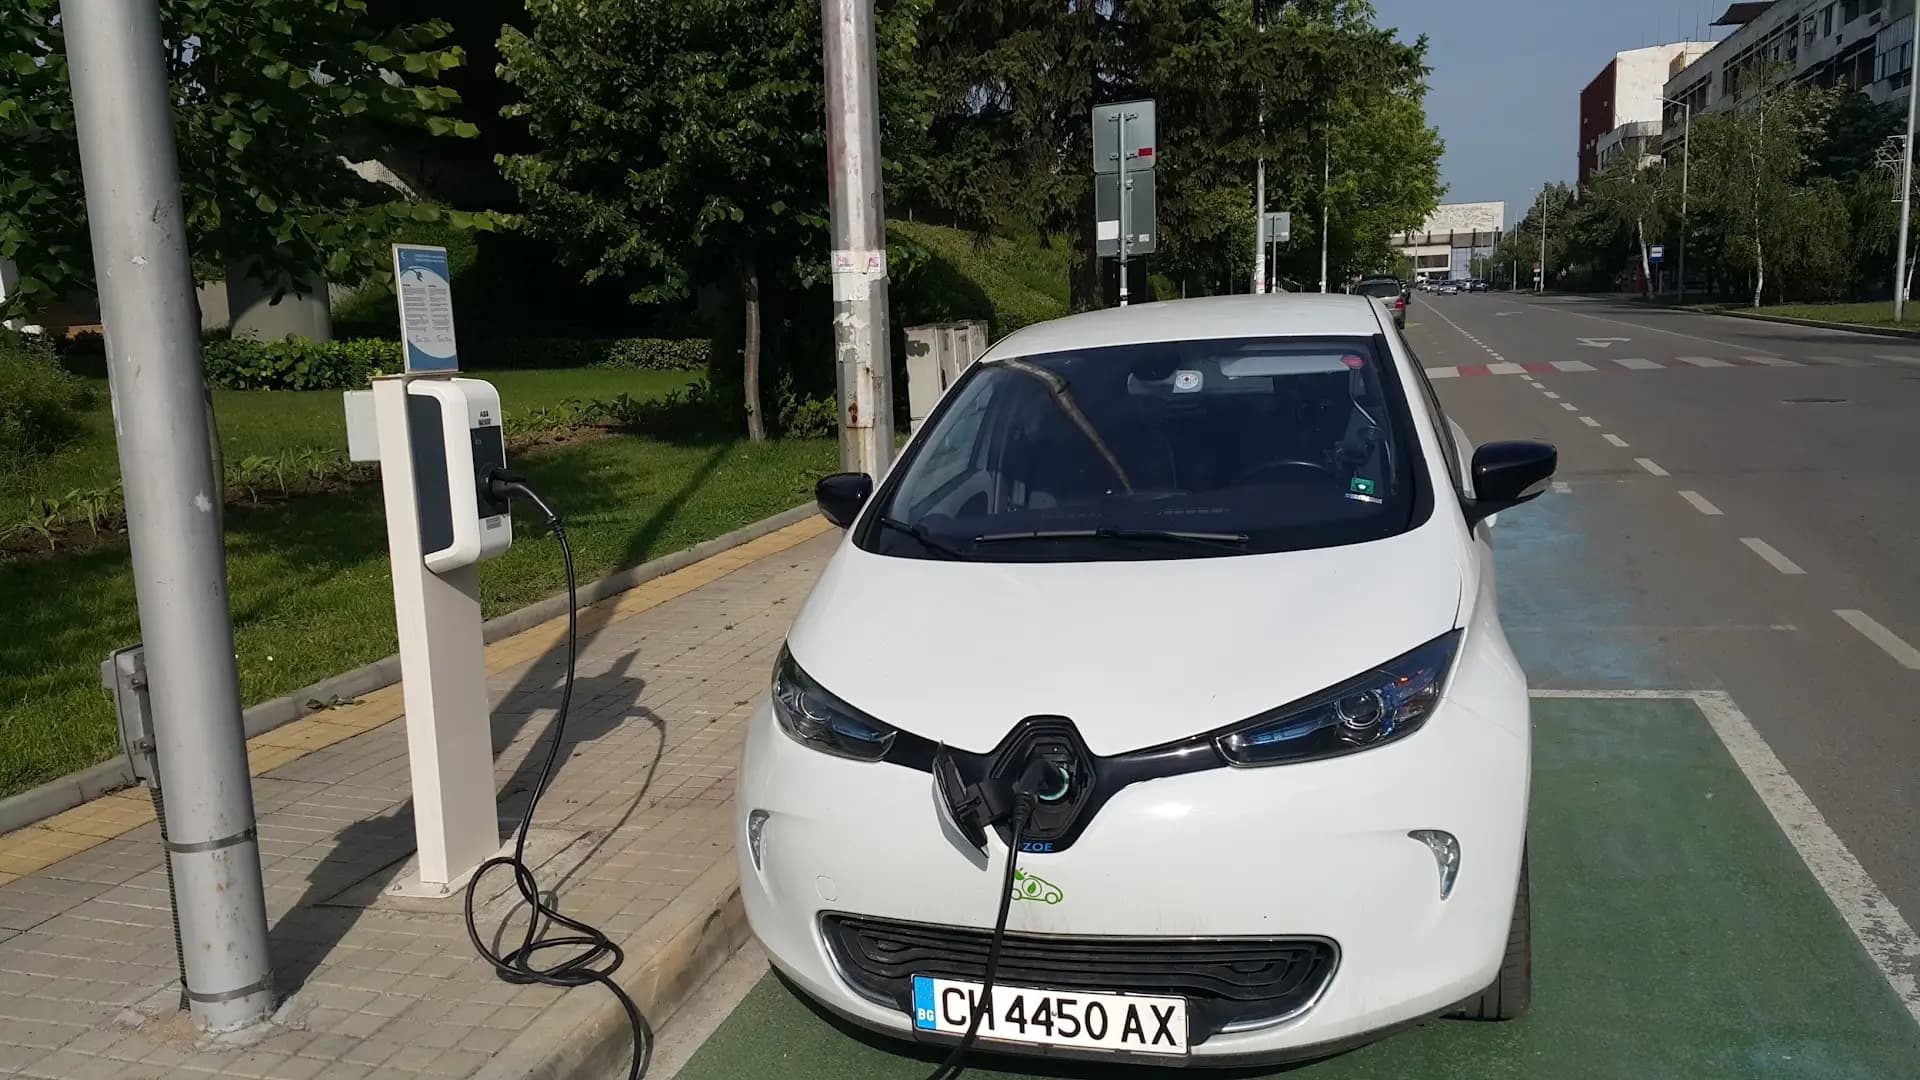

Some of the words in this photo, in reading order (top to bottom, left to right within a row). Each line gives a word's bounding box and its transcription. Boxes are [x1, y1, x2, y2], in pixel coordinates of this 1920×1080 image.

[1023, 842, 1054, 852] ZOE
[917, 1007, 935, 1022] BG
[1004, 995, 1109, 1041] 4450
[1121, 1003, 1177, 1047] AX
